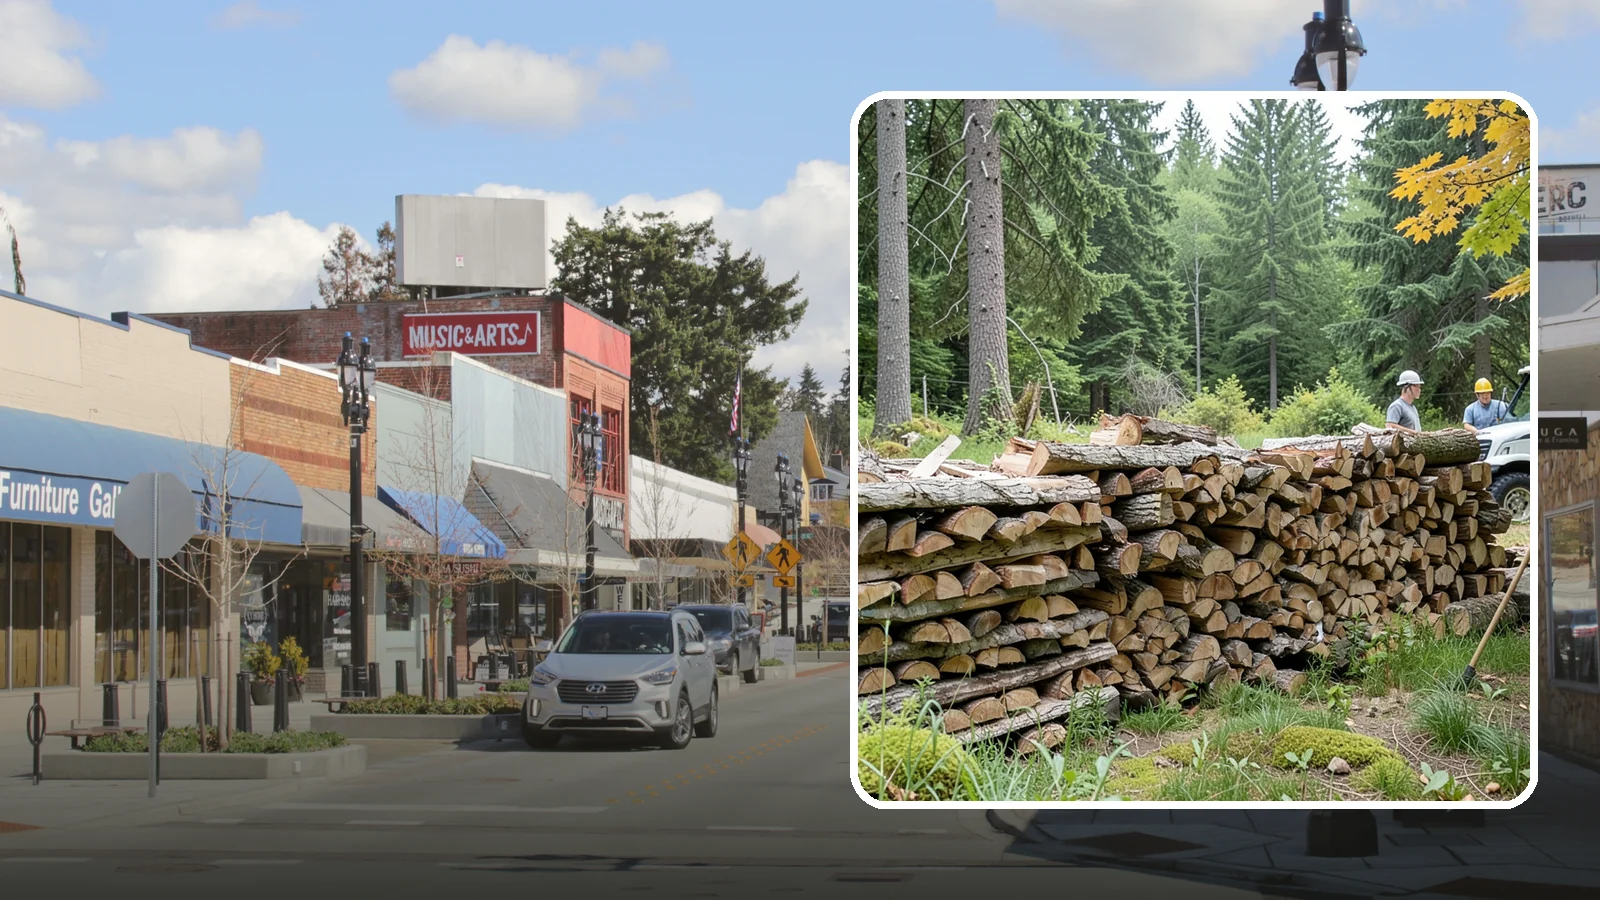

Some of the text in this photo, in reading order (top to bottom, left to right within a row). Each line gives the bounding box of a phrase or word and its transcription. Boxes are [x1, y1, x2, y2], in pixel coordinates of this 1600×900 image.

[409, 323, 519, 349] MUSIC&ARTS
[0, 472, 121, 519] Furniture Gal
